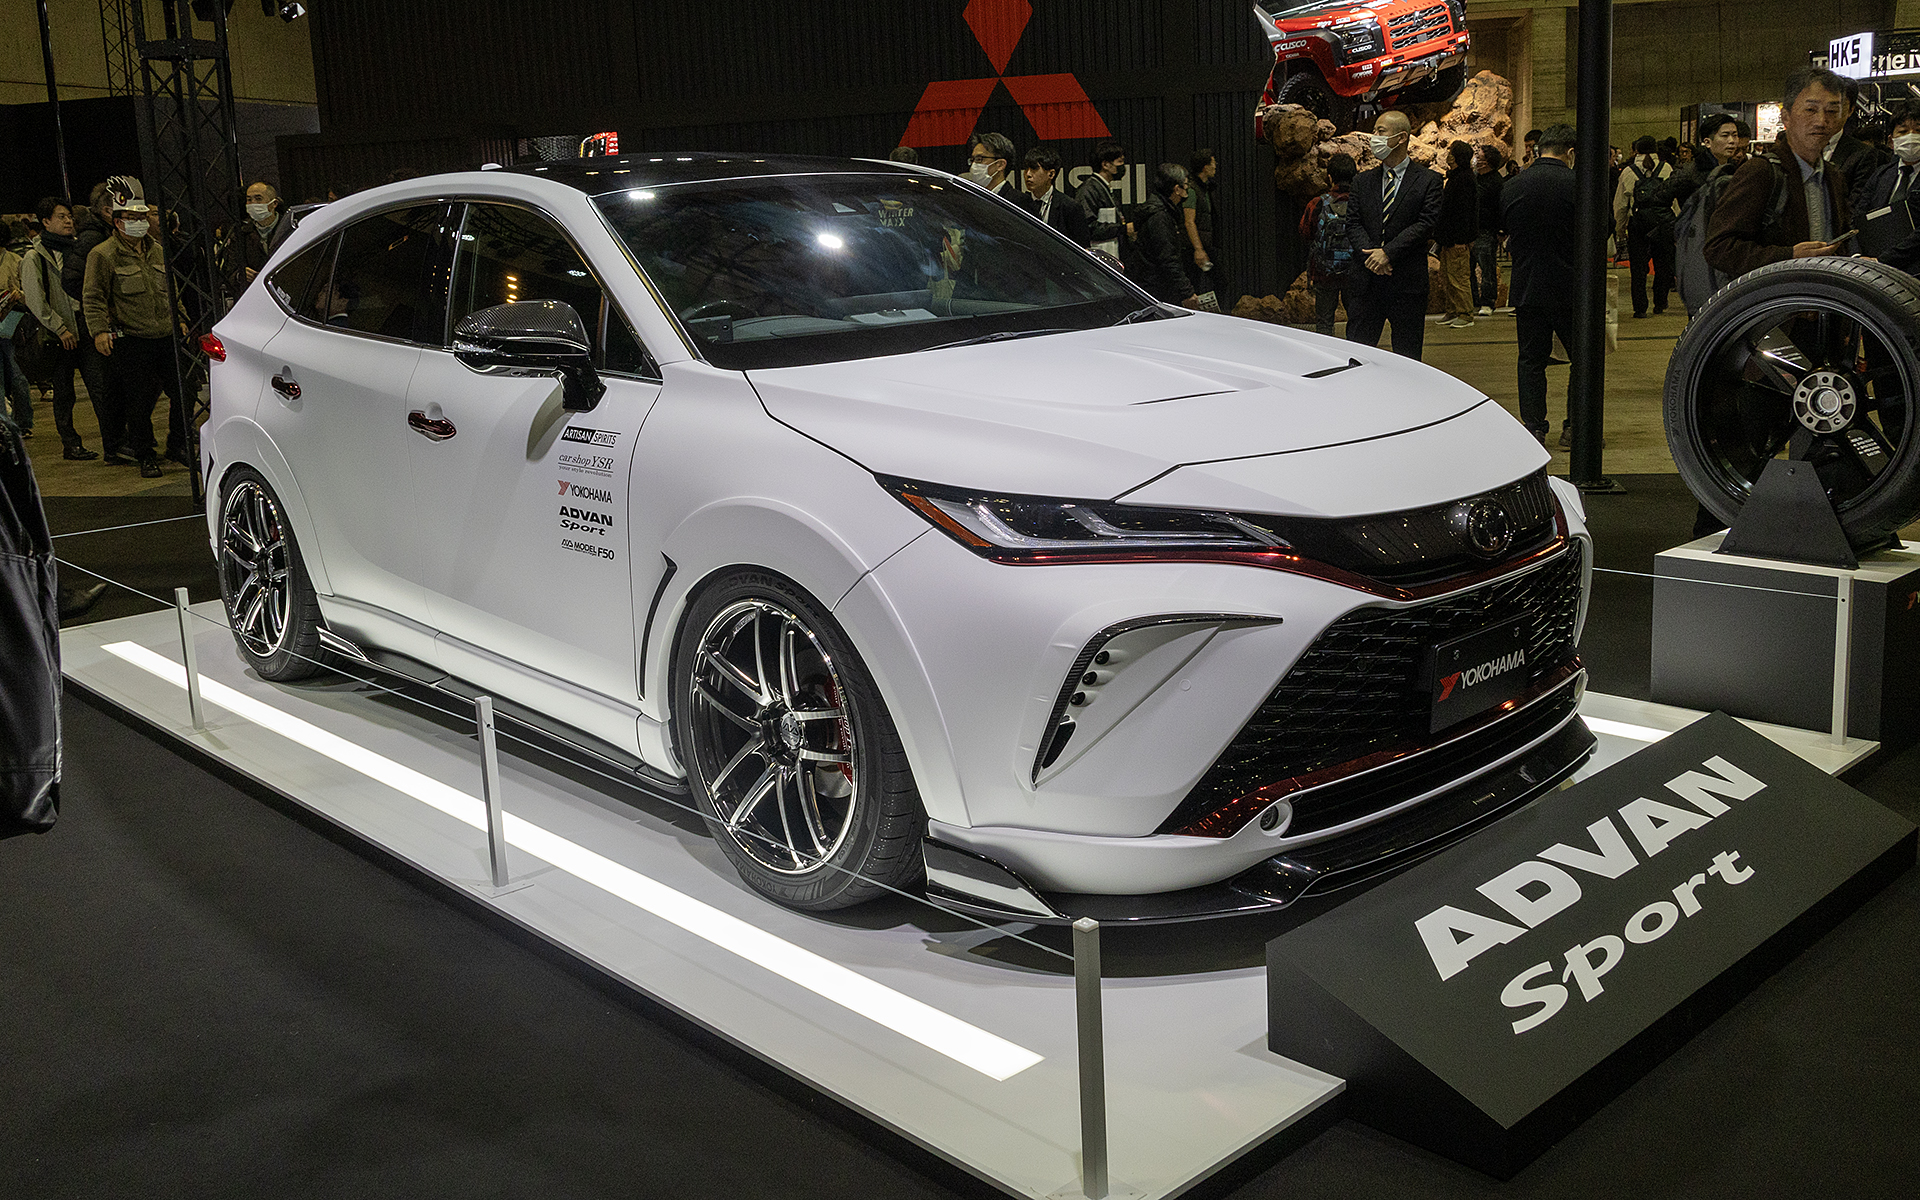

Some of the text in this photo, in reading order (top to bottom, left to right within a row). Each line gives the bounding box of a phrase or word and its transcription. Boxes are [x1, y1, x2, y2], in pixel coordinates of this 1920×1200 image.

[1280, 39, 1307, 51] CUSCO
[1831, 38, 1861, 69] HKS
[1669, 369, 1682, 425] YOKOHAMA
[563, 428, 617, 446] ARTISAN SPIRITS
[558, 454, 614, 470] car shop YSR
[569, 483, 613, 504] YOKOHAMA
[559, 505, 613, 527] ADVAN
[560, 519, 606, 536] Sport
[573, 541, 597, 554] MODEL
[597, 547, 615, 561] F50
[1461, 649, 1525, 689] YOKOHAMA
[1414, 755, 1768, 982] ADVAN
[1500, 850, 1755, 1035] Sport
